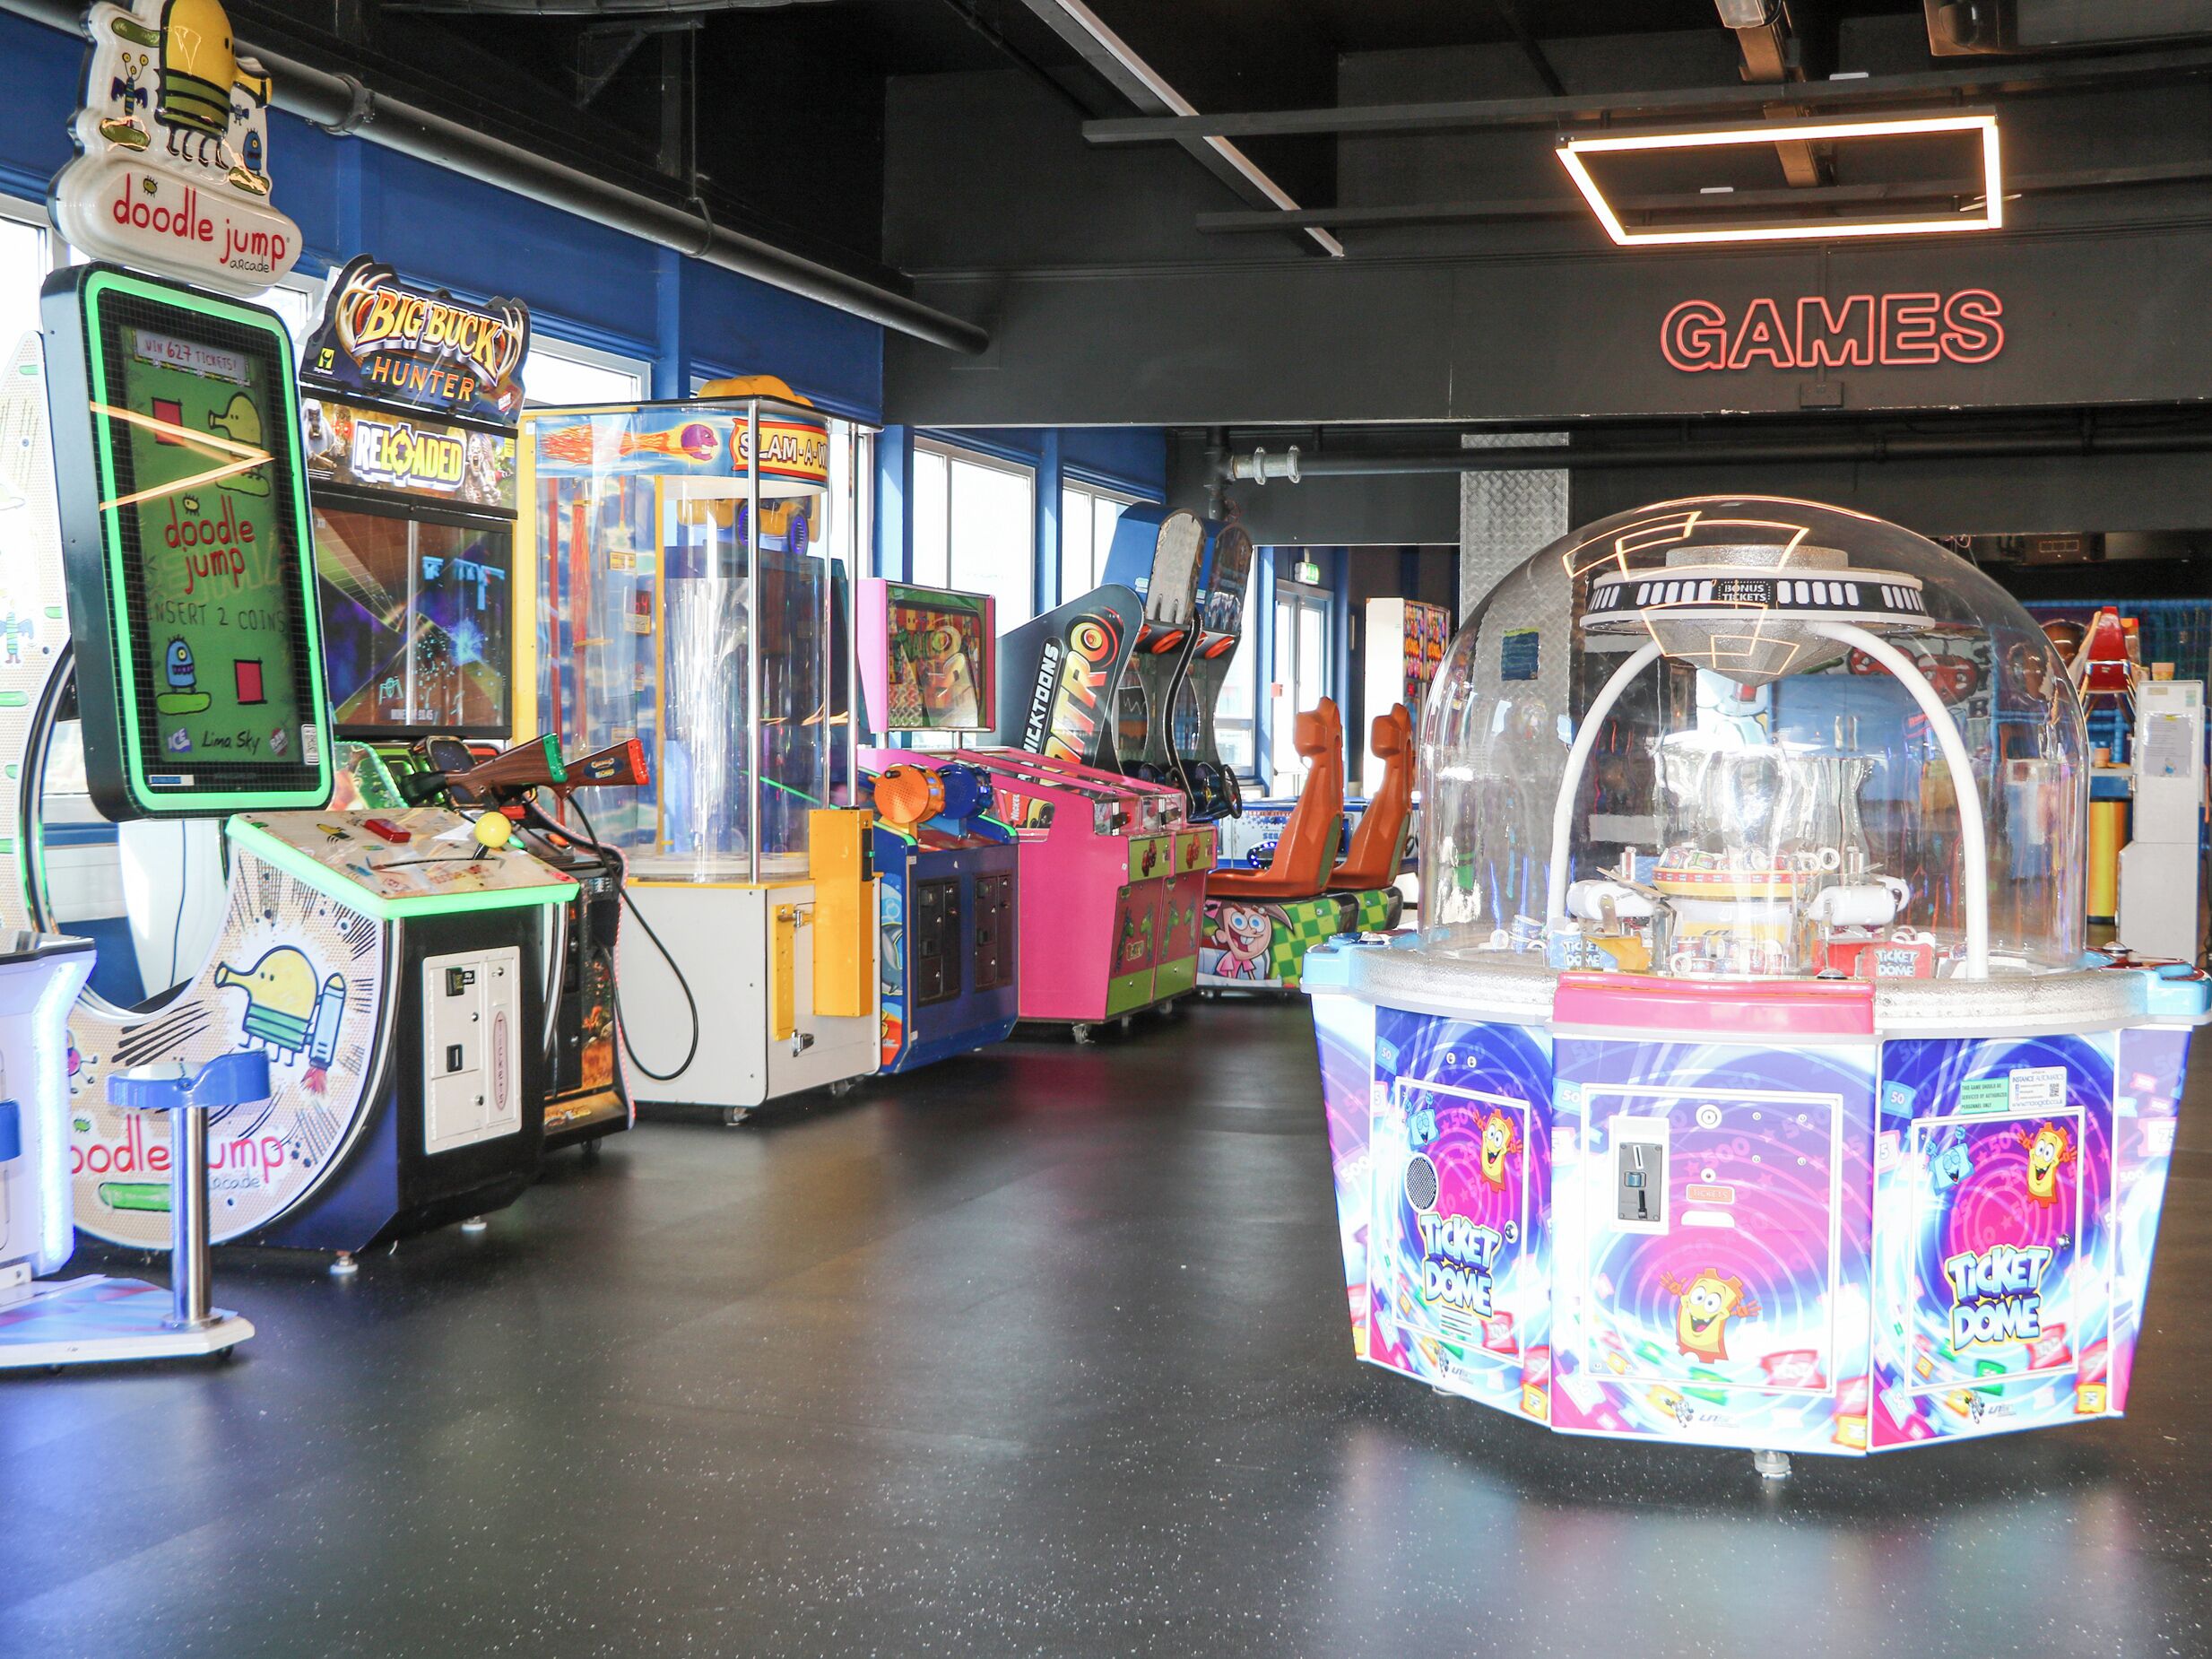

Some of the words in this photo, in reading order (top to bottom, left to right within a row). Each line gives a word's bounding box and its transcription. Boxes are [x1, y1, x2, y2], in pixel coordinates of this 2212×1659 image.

[113, 173, 213, 241] doodle
[220, 219, 285, 271] jump
[355, 287, 426, 348] BIG
[423, 301, 504, 386] BUCK
[1661, 289, 2005, 372] GAMES
[167, 341, 191, 361] 627
[371, 356, 475, 402] HUNTER
[354, 423, 464, 480] RELOADED
[165, 494, 256, 549] doodle
[183, 547, 246, 595] jump
[1724, 584, 1765, 593] BONUS
[1722, 593, 1766, 602] TICKETS
[217, 607, 229, 625] 2
[237, 730, 261, 755] Sky
[1262, 832, 1279, 840] SEG
[1878, 964, 1915, 977] DOME
[1382, 1047, 1392, 1060] 50
[1562, 1089, 1582, 1103] 50
[1890, 1091, 1904, 1105] 50
[72, 1114, 171, 1174] oodle
[209, 1136, 283, 1184] ump
[1424, 1259, 1494, 1318] DOME
[1953, 1296, 2041, 1351] DOME
